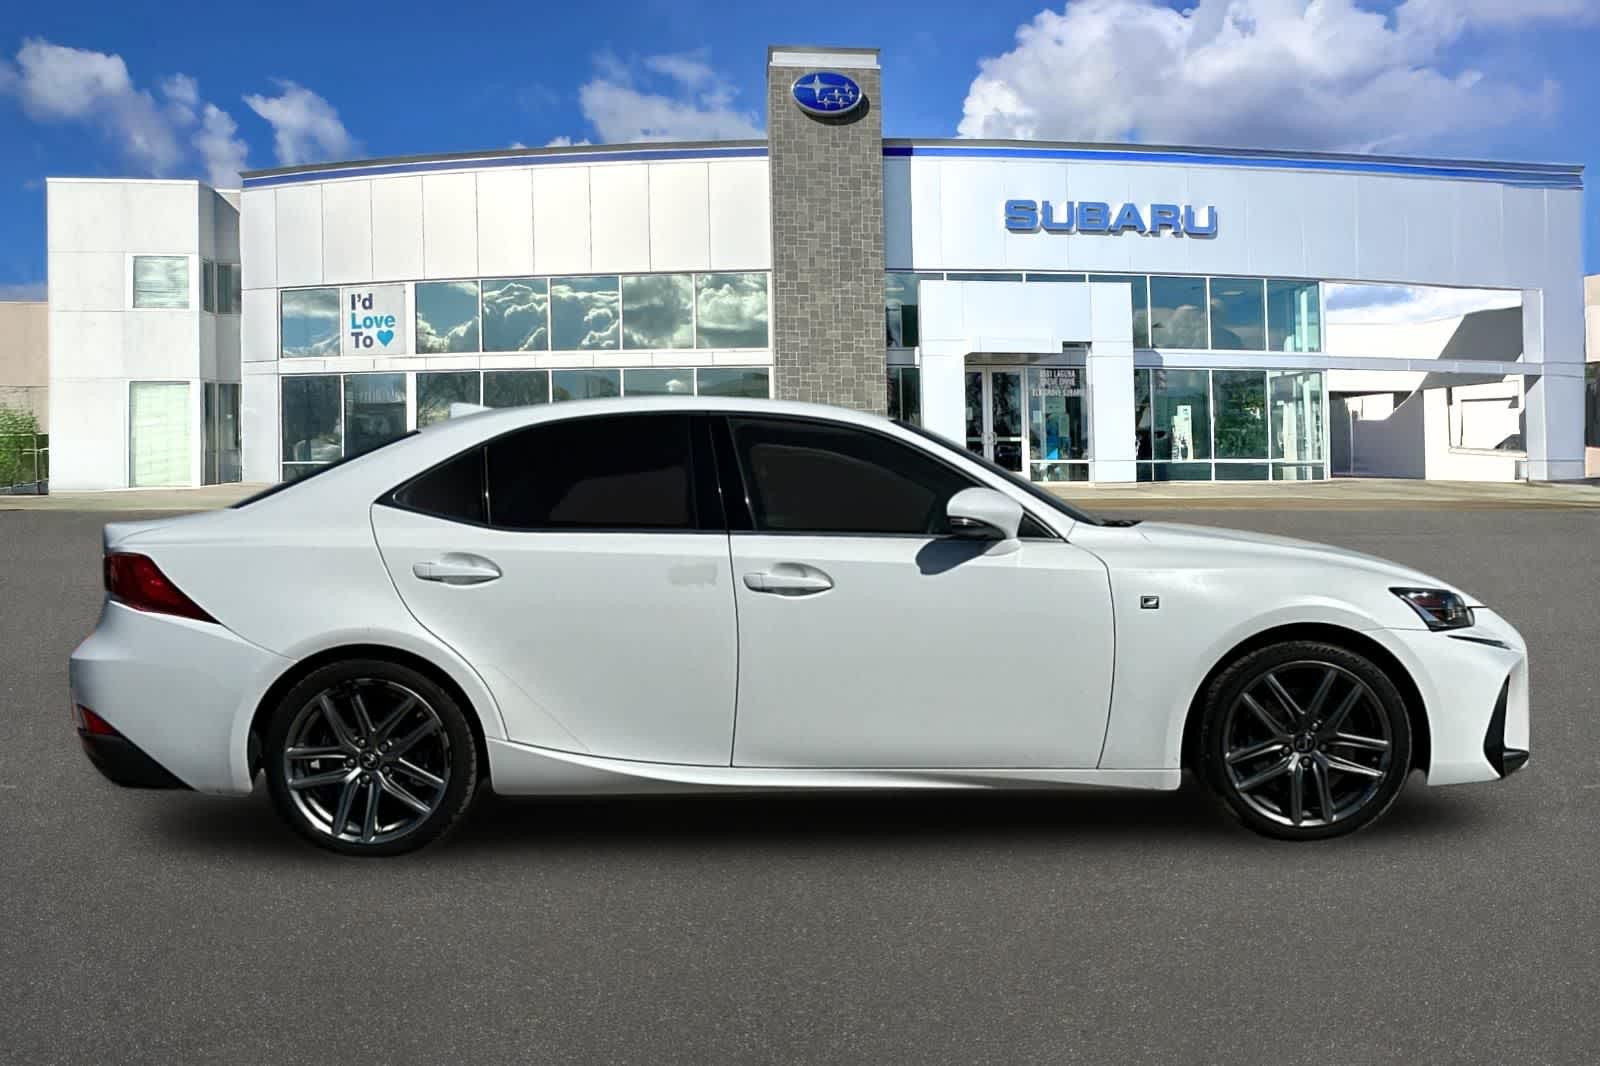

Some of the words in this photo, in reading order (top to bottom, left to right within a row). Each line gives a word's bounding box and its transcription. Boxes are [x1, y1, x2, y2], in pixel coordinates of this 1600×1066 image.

[1004, 199, 1216, 237] SUBARU
[351, 293, 373, 310] I'd
[351, 312, 396, 329] Love
[351, 331, 374, 348] To
